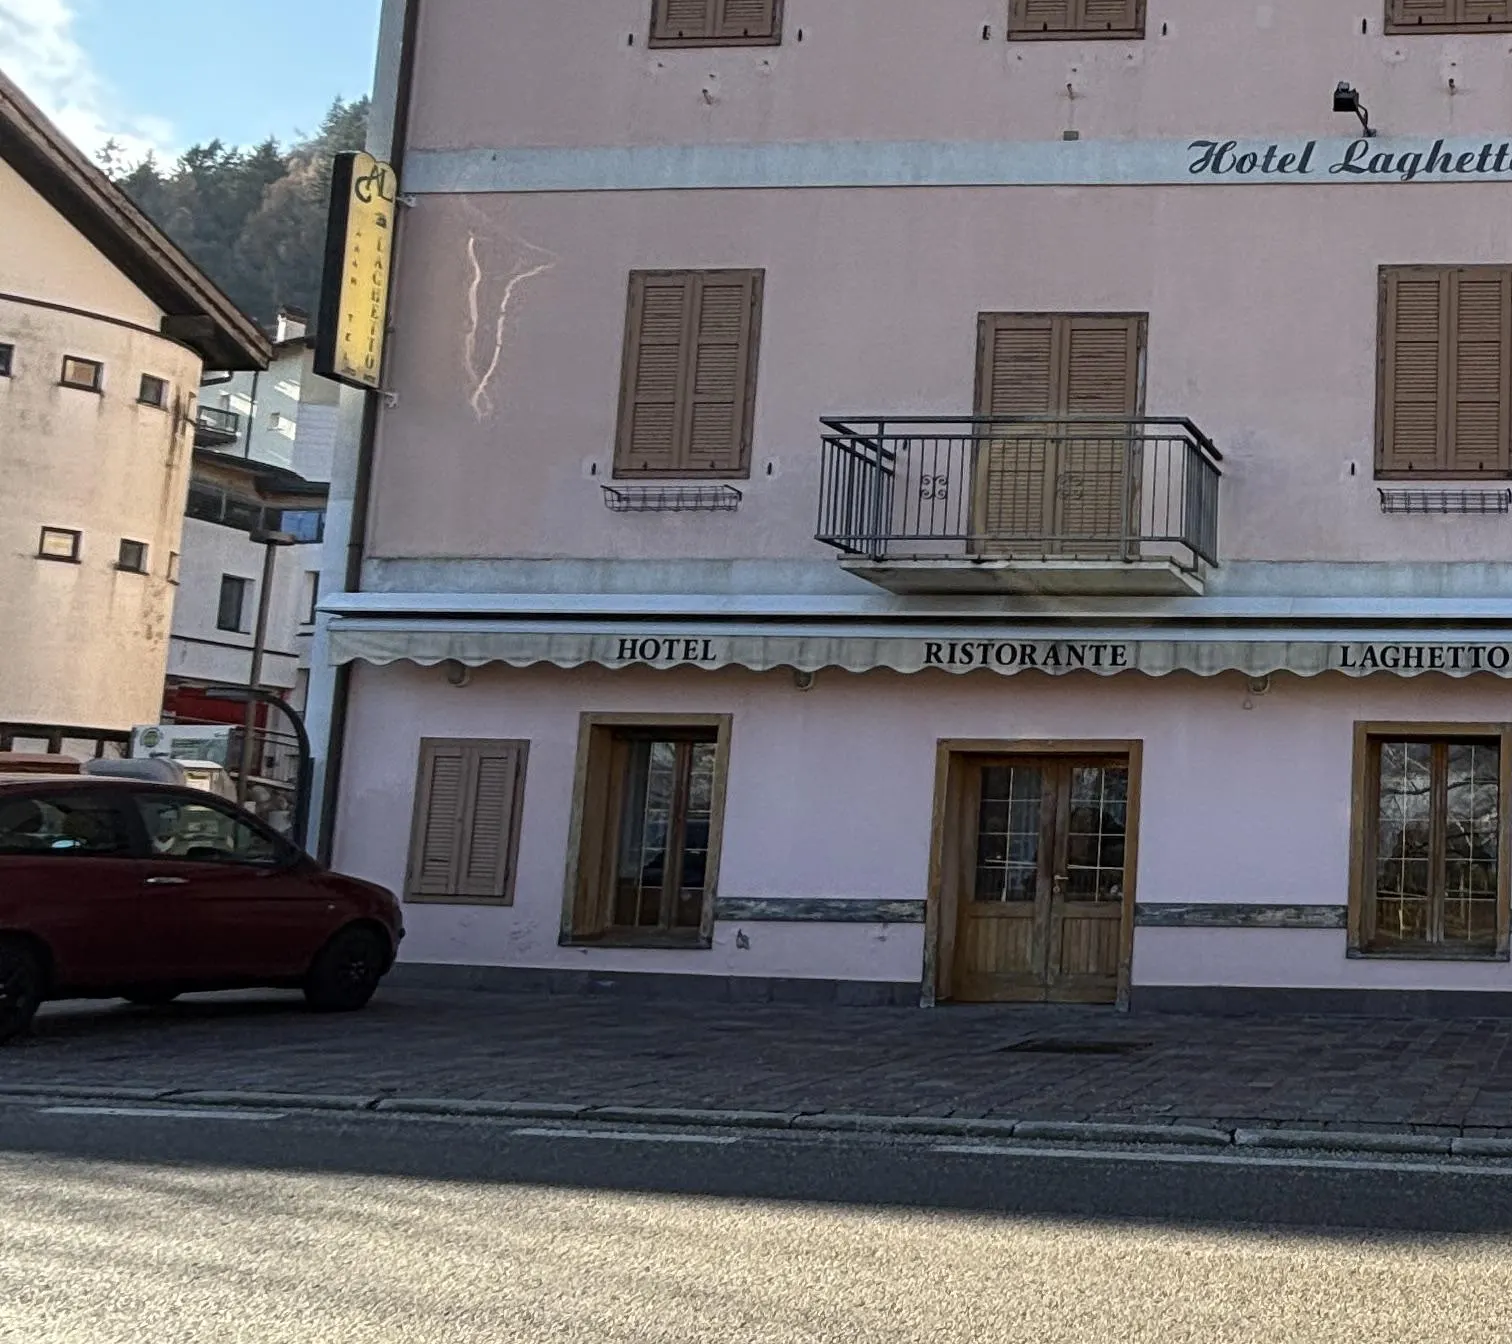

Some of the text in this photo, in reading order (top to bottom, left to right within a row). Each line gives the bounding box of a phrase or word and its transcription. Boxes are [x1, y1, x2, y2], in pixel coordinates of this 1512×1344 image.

[1188, 140, 1318, 174] Hotel
[616, 638, 1510, 668] HOTEL RISTORANTE LAGHETTO
